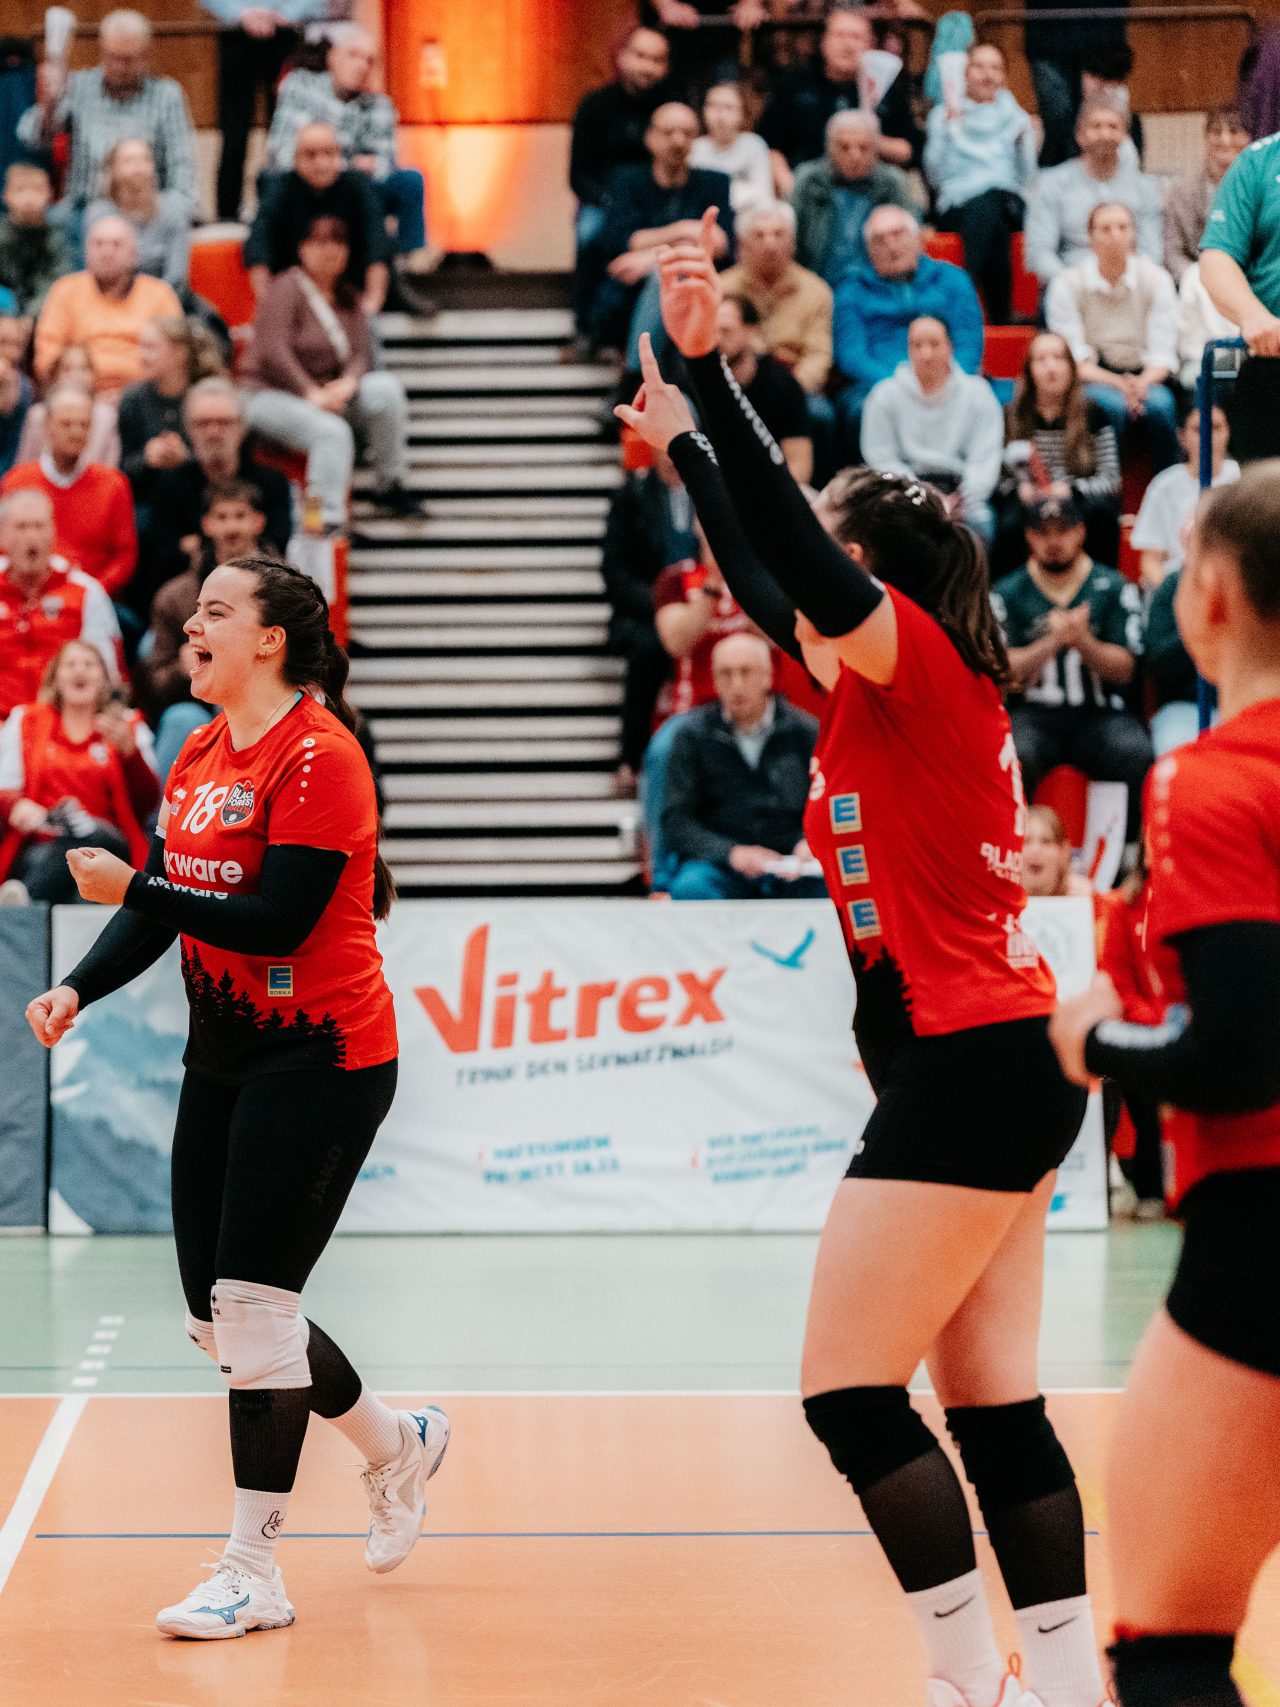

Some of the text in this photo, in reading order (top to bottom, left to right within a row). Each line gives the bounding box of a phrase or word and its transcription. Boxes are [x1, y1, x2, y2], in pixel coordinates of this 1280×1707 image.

[180, 780, 229, 835] 18
[227, 797, 254, 807] FOREST
[413, 922, 729, 1054] Vitrex
